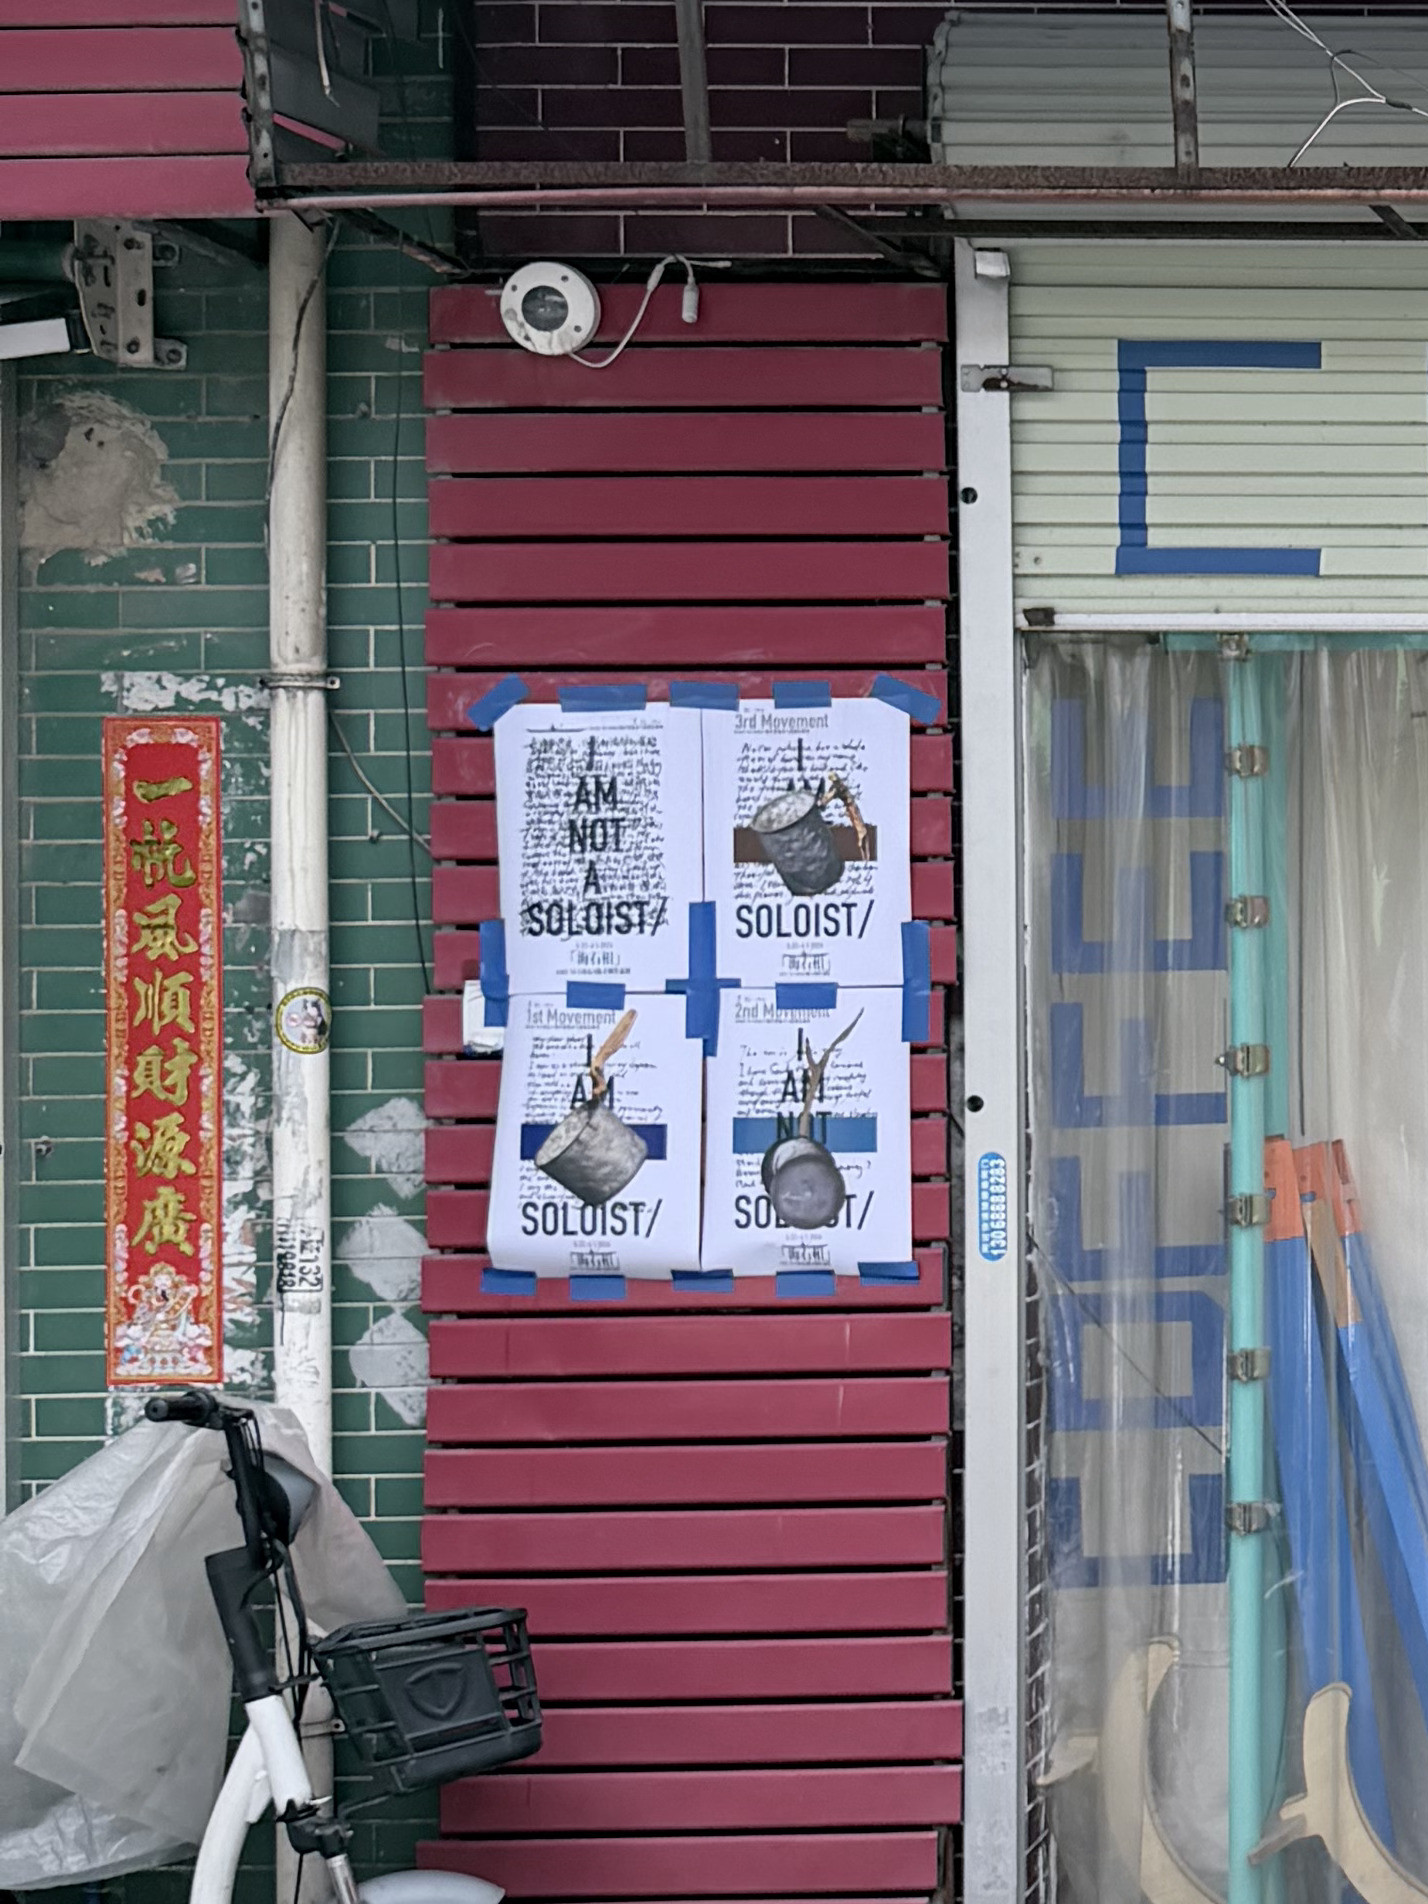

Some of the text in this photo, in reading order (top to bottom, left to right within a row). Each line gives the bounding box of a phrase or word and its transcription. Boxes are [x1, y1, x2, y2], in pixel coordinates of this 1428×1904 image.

[735, 713, 829, 730] 3rd Movement
[573, 775, 618, 814] AM
[569, 818, 626, 854] NOT
[583, 860, 601, 897] A
[736, 899, 875, 939] SOLOIST/
[527, 1008, 616, 1026] 1st Movement
[735, 1002, 758, 1019] 2nd
